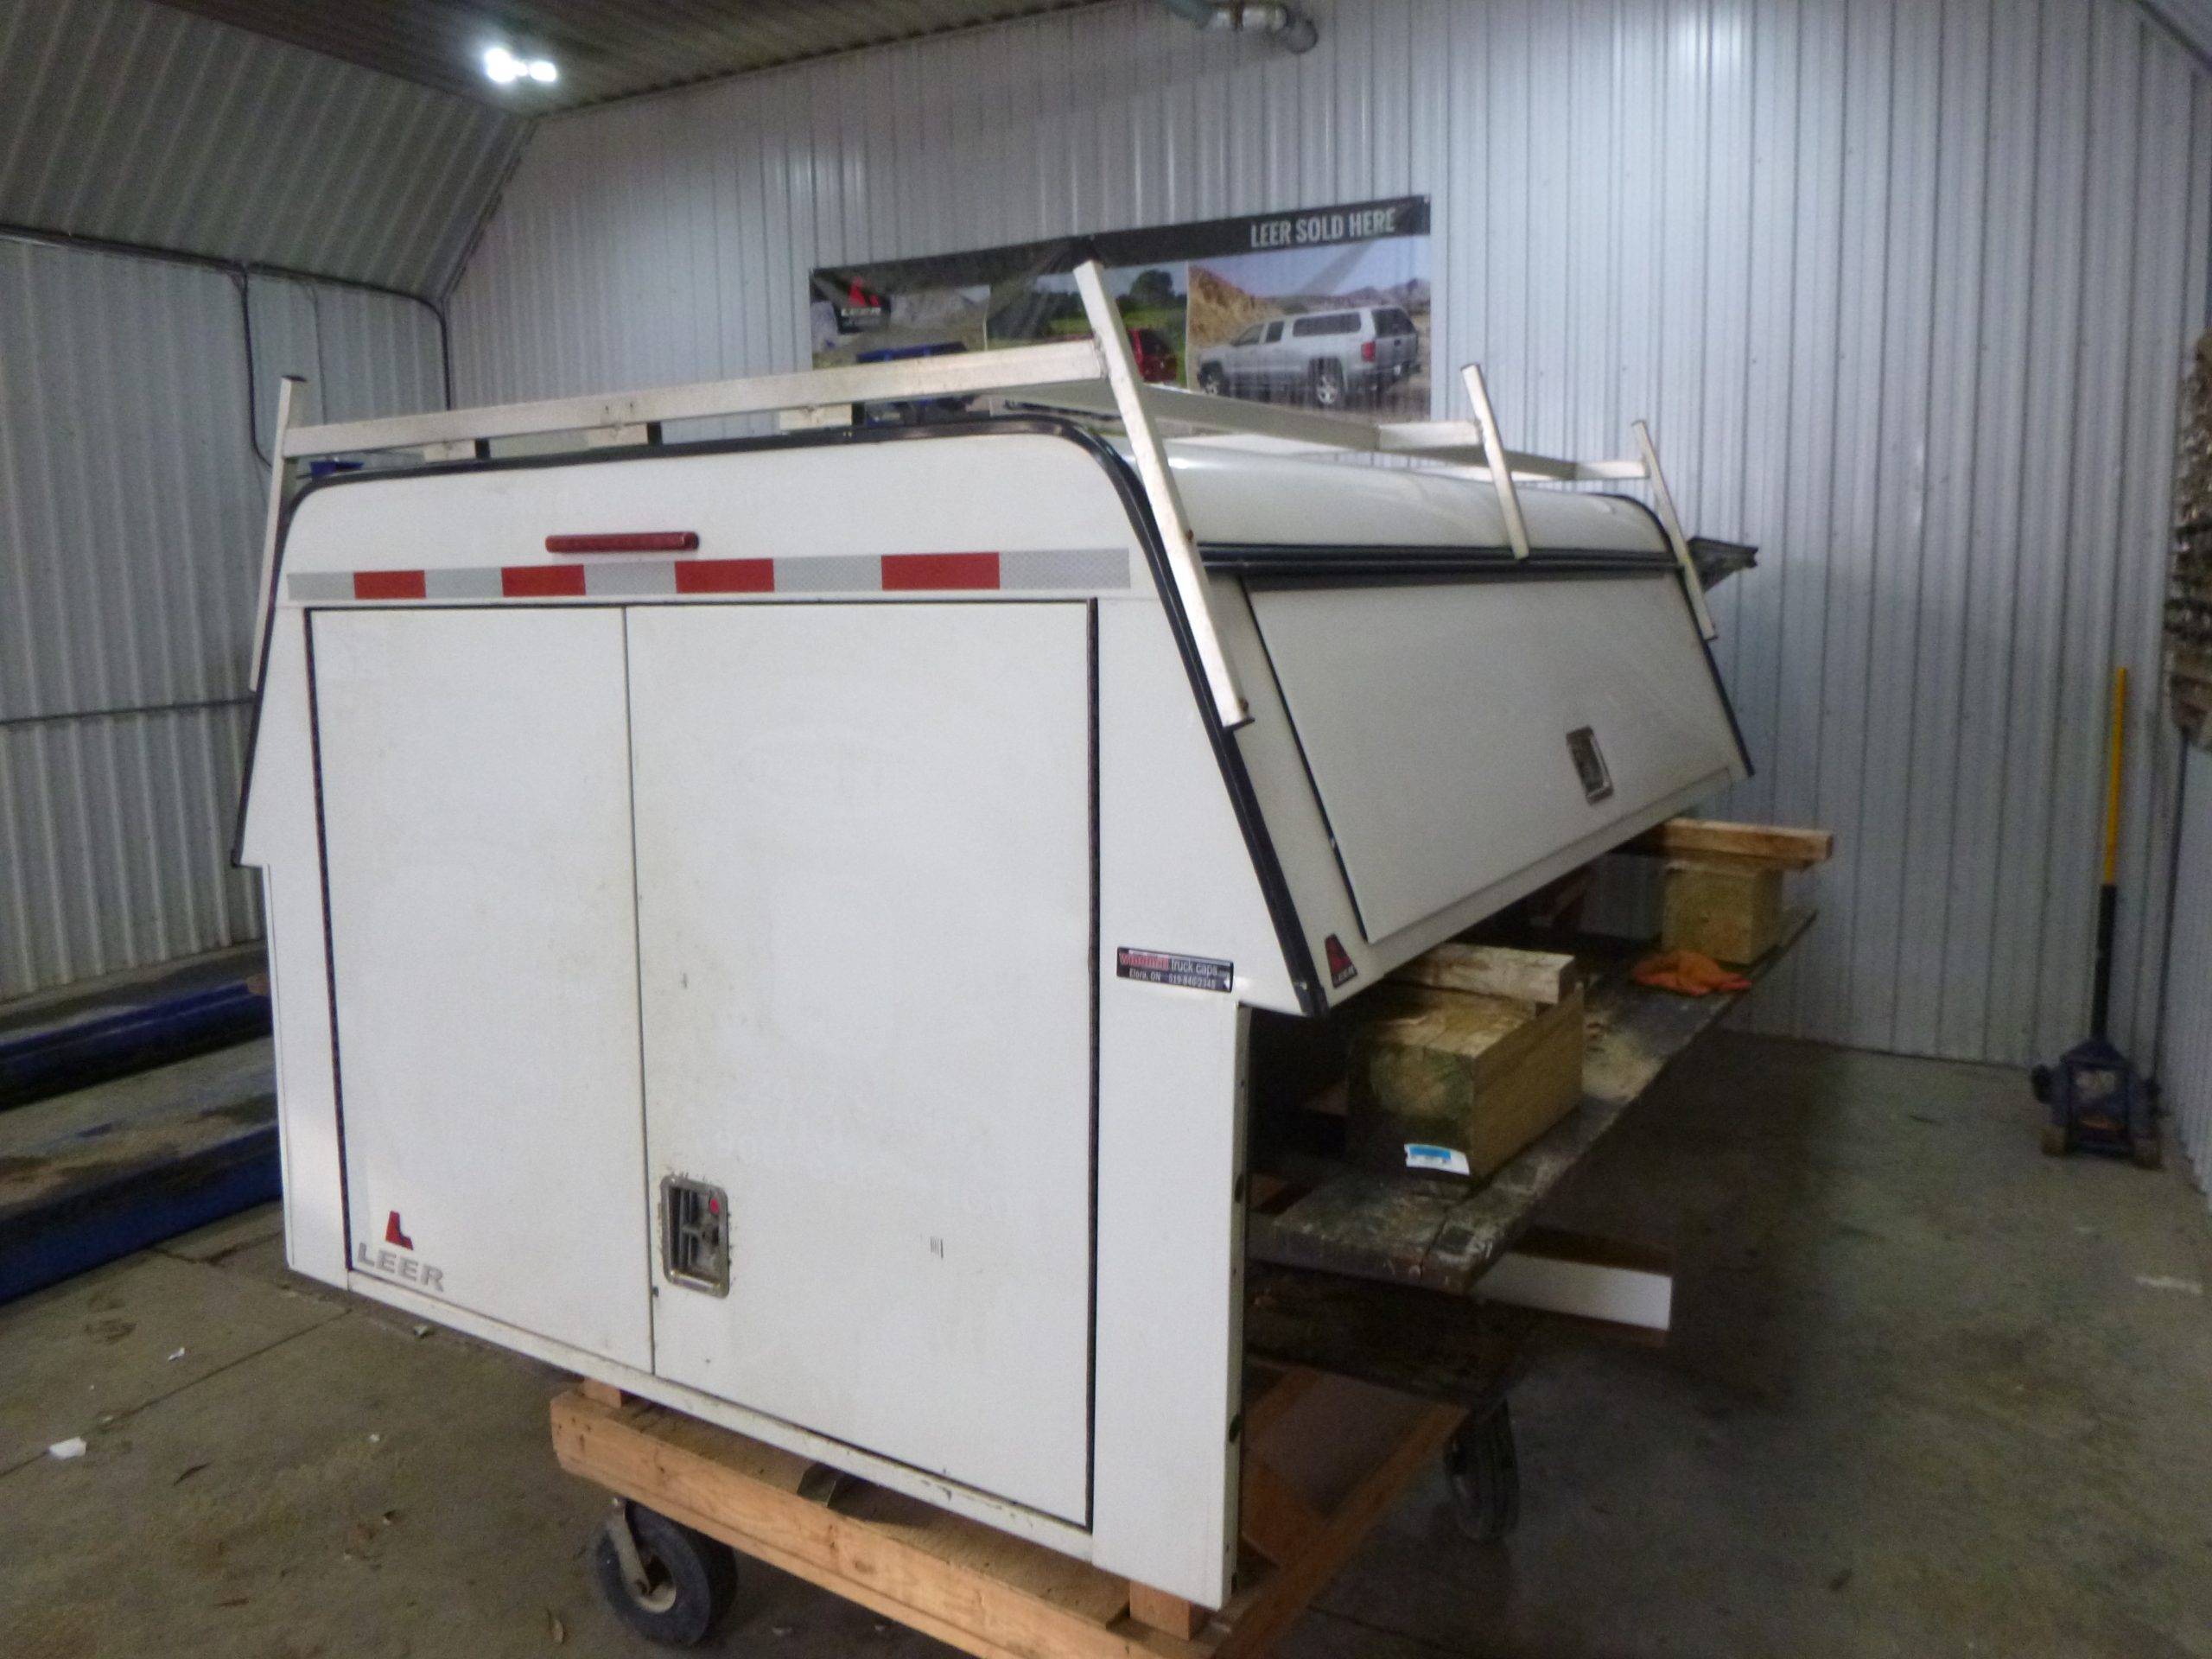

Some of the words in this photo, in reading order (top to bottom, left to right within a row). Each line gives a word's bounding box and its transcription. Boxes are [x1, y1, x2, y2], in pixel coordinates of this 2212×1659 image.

[1250, 220, 1291, 248] LEER
[1296, 214, 1344, 243] SOLD
[1349, 207, 1395, 238] HERE
[358, 1243, 444, 1293] LEER
